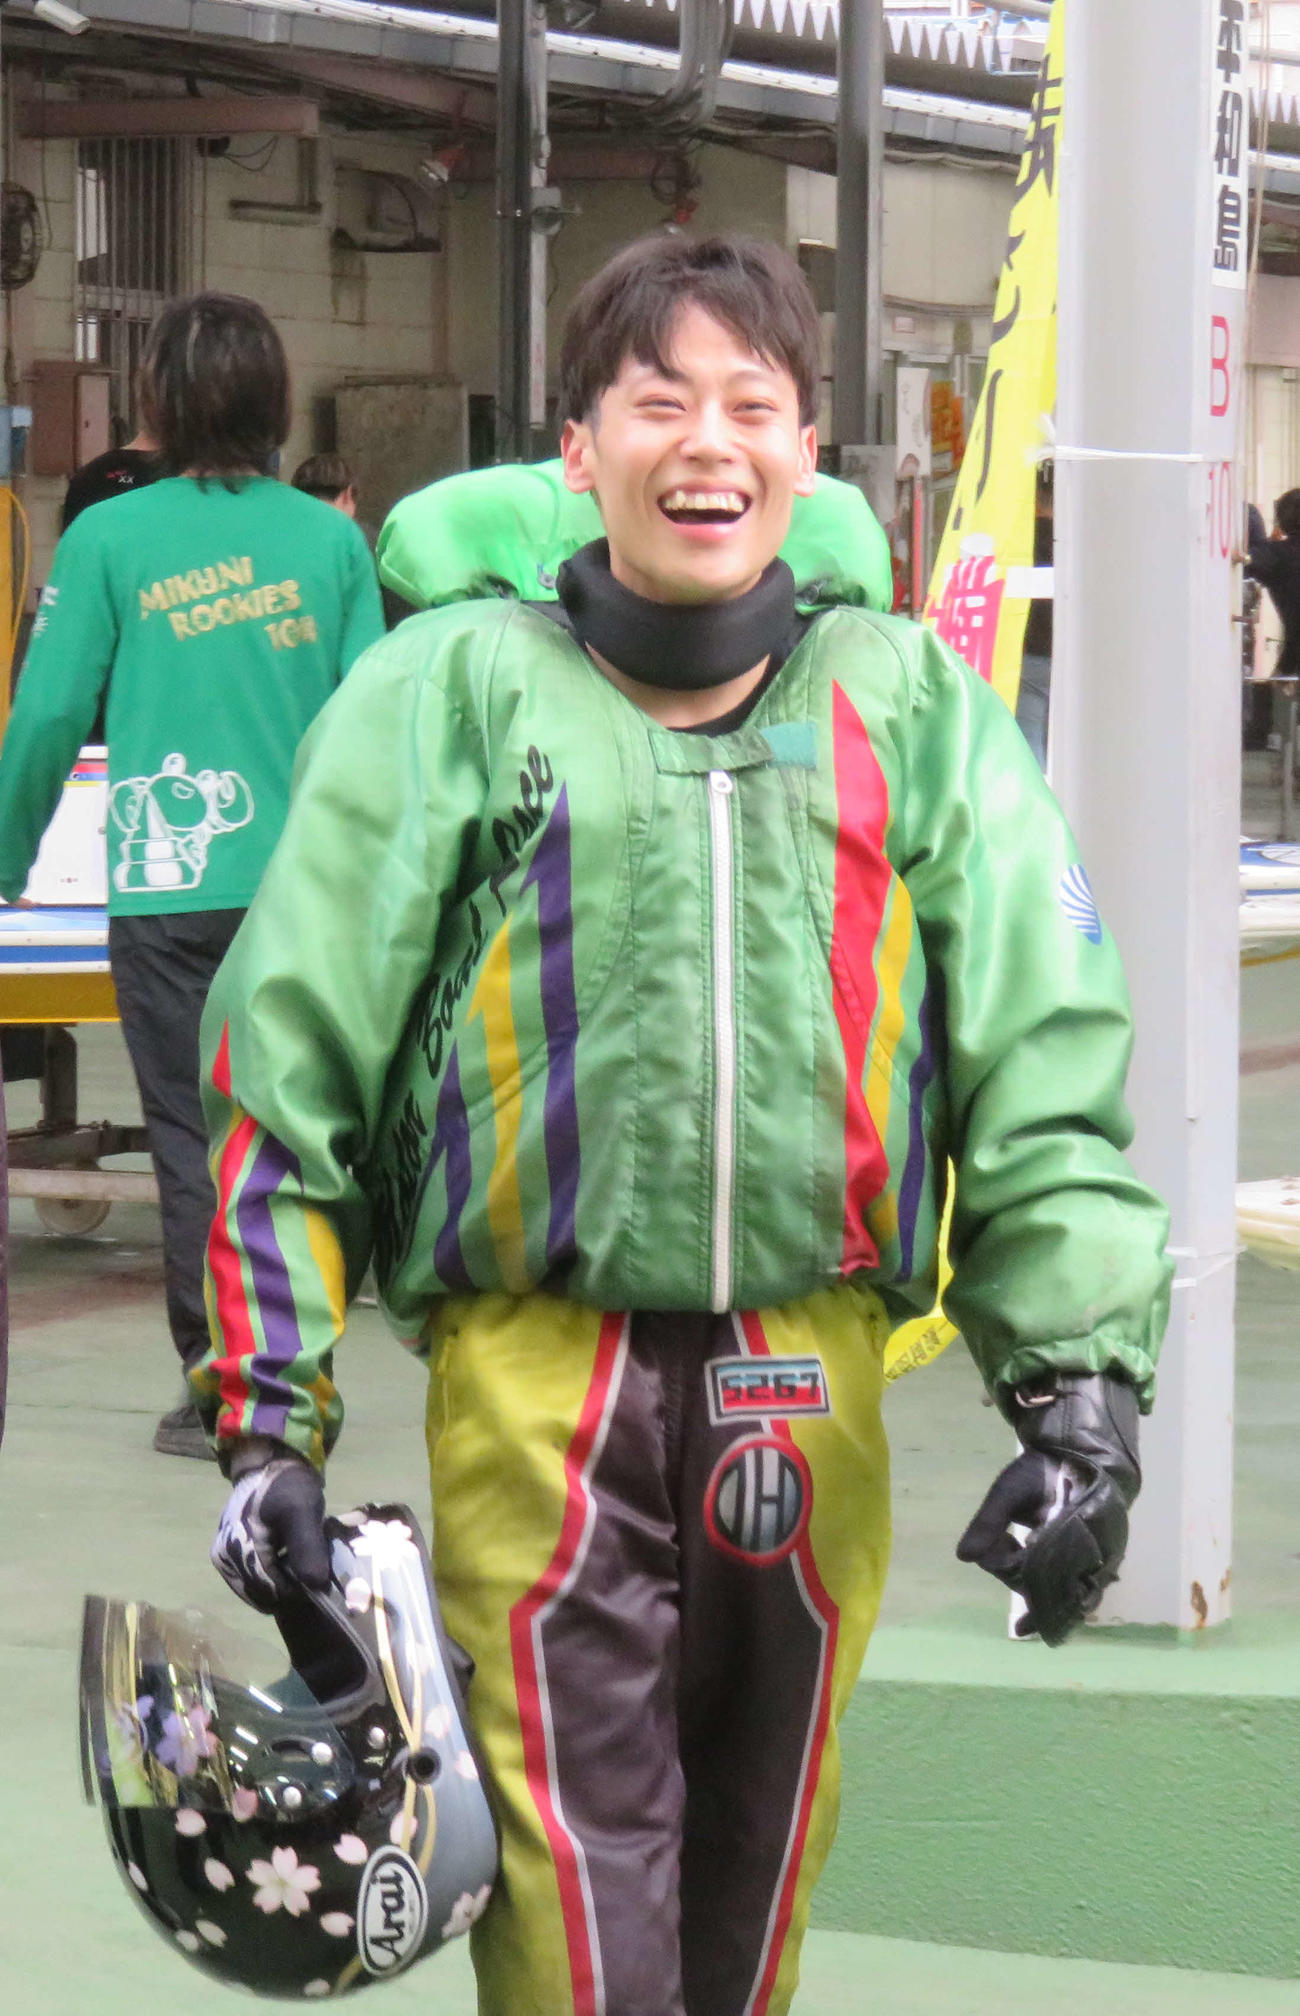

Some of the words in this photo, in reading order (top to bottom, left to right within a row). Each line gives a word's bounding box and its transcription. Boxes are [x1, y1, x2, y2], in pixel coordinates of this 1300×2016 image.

[1213, 0, 1243, 272] 平和島
[1210, 315, 1230, 416] B
[138, 556, 254, 620] MIKUNI
[168, 579, 302, 641] ROOKIES
[369, 1867, 406, 1963] Arai
